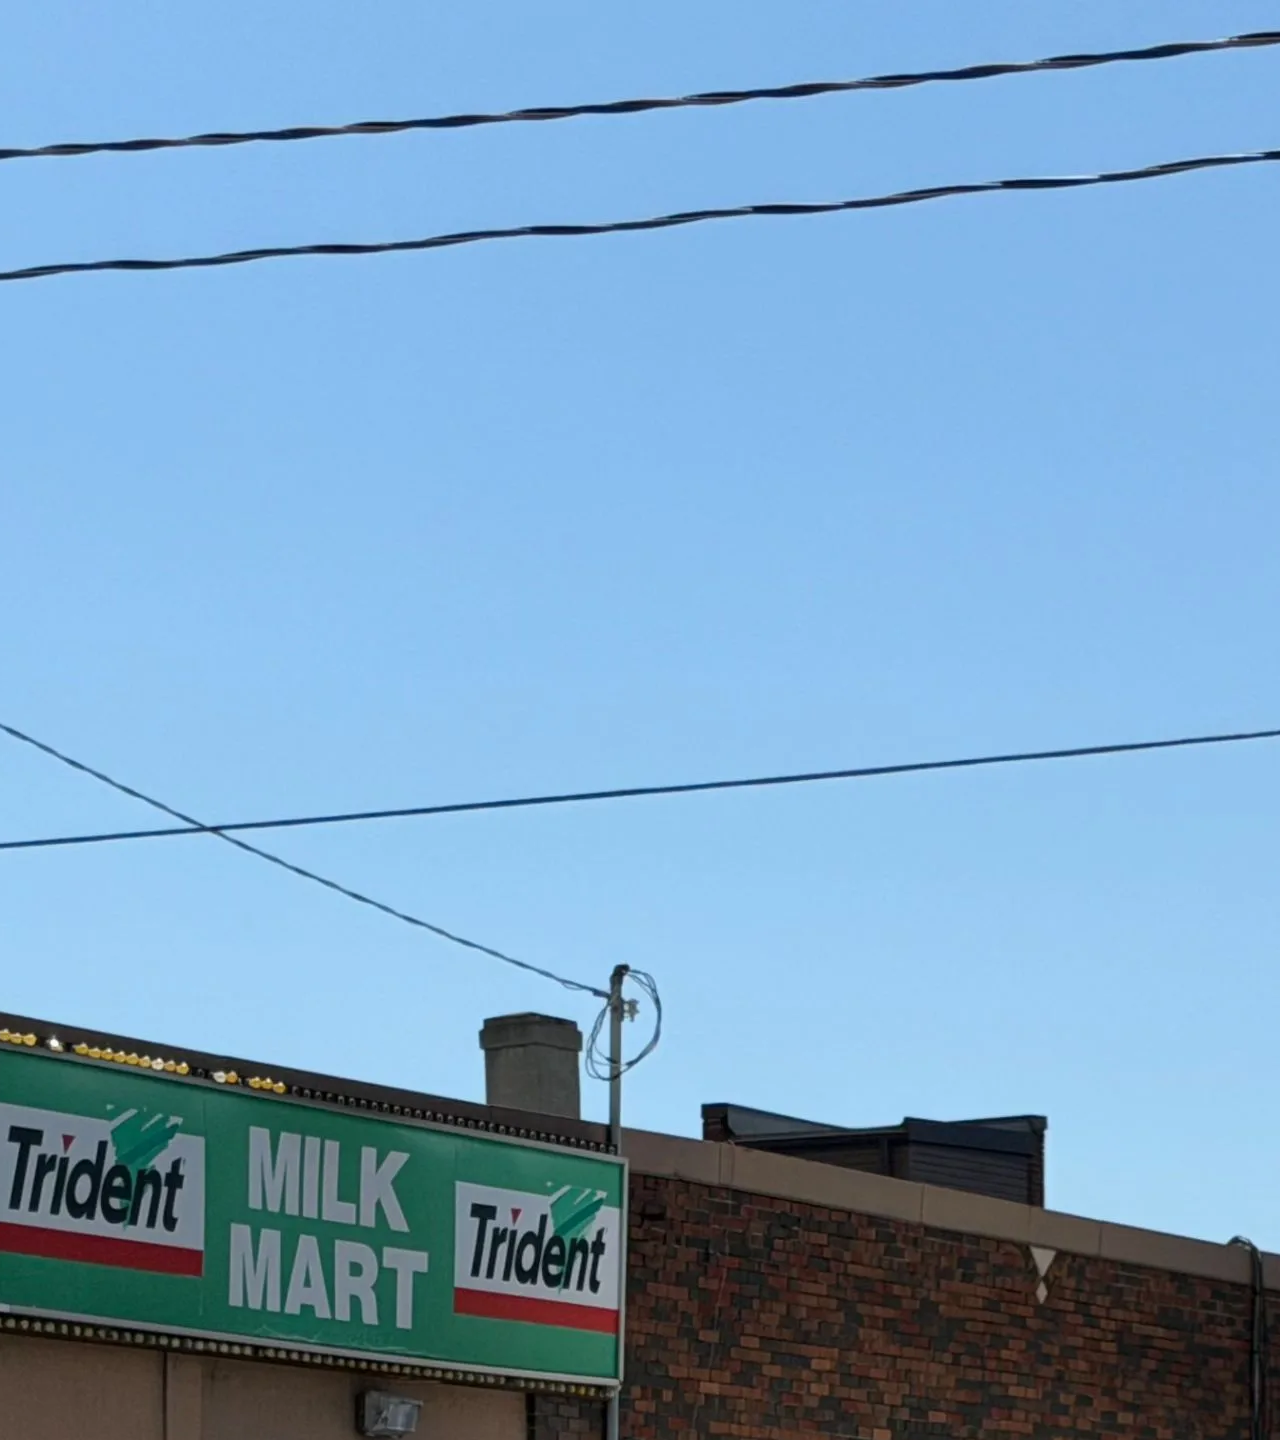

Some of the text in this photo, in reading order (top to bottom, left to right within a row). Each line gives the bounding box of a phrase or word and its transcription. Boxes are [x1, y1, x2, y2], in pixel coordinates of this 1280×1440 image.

[7, 1125, 185, 1232] Trident
[247, 1126, 410, 1232] MILK
[228, 1224, 428, 1330] MART
[469, 1203, 607, 1294] Trident
